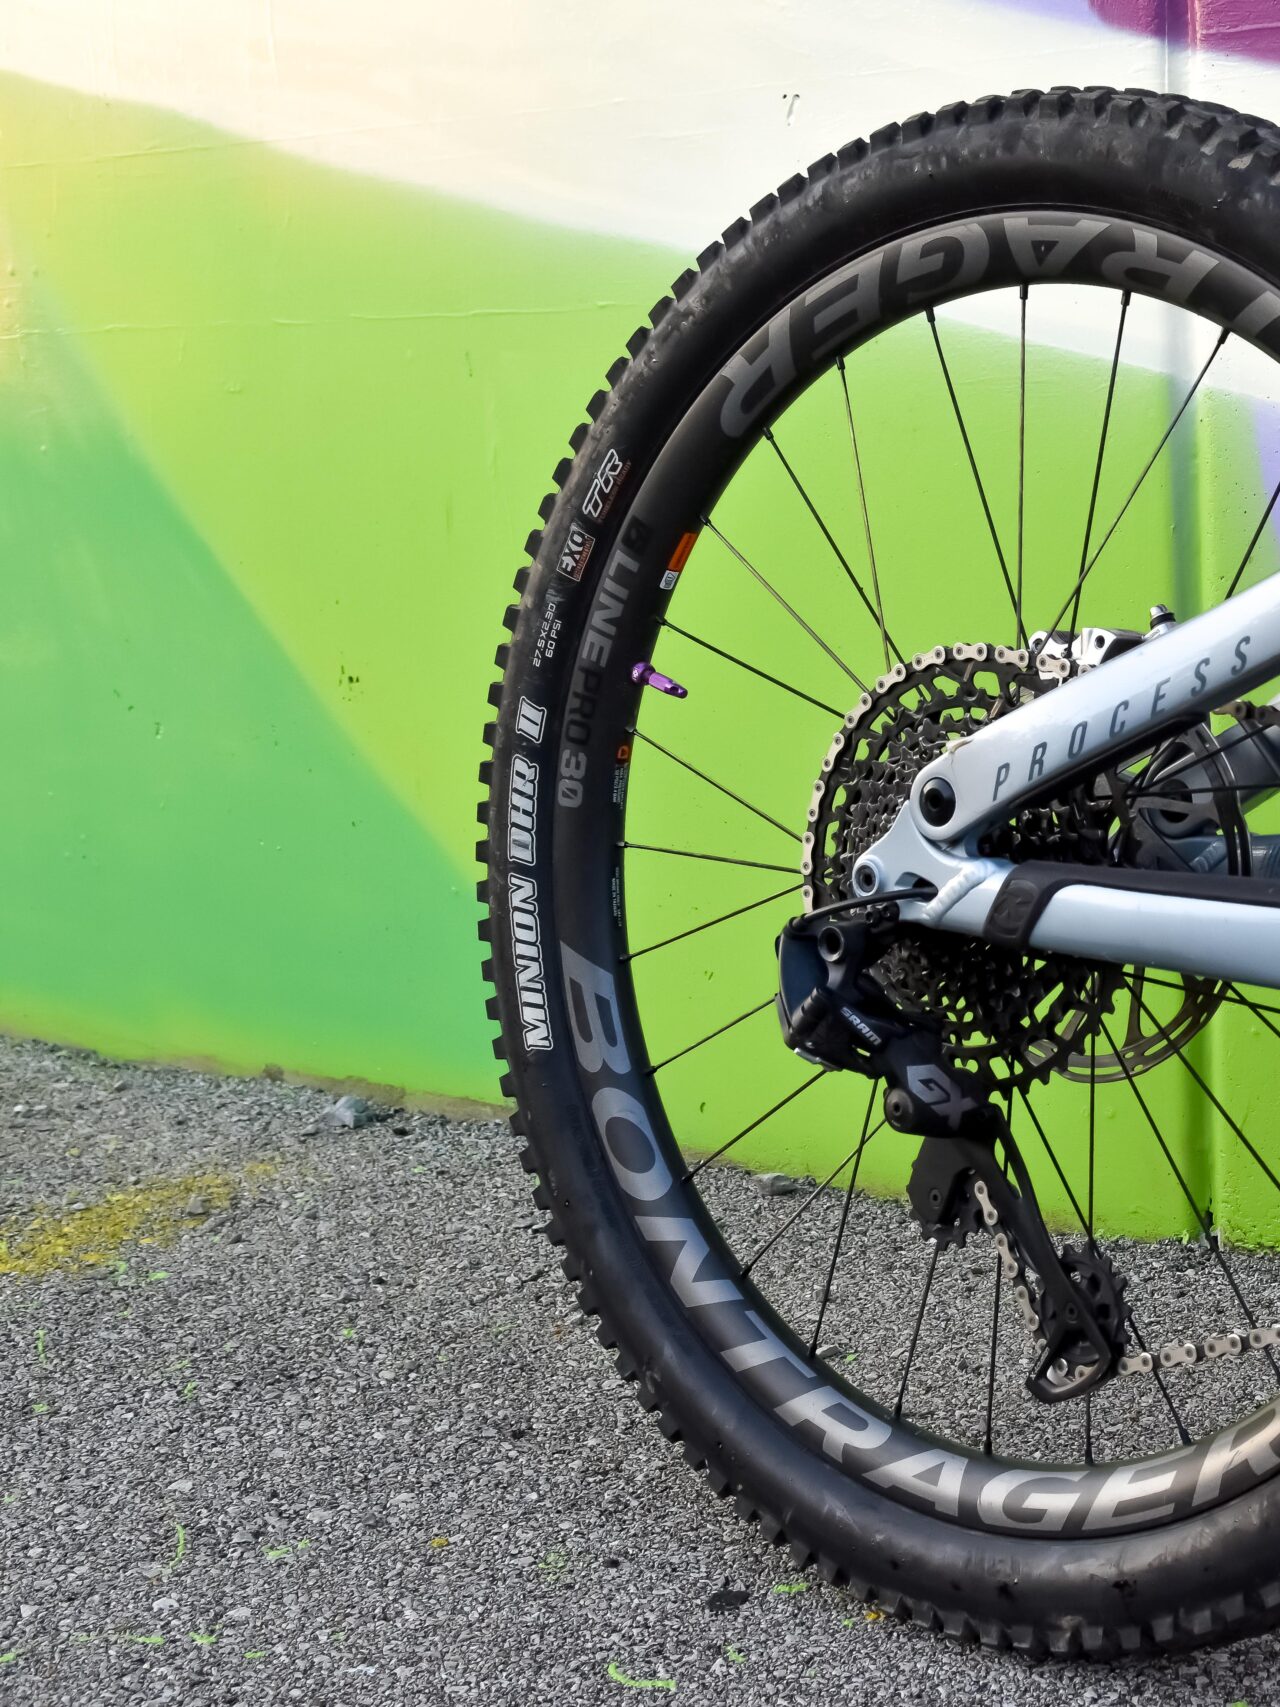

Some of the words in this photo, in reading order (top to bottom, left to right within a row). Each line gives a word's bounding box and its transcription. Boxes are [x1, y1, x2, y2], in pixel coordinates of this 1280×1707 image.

[581, 448, 624, 518] TR
[557, 529, 589, 573] EXO
[532, 602, 556, 667] 27.5X2.30
[550, 620, 563, 640] PSI
[582, 549, 642, 668] LINE
[545, 639, 556, 659] 60
[516, 696, 547, 744] II
[563, 666, 602, 746] PRO
[992, 635, 1253, 802] PROCESS
[508, 754, 539, 866] DHR
[557, 748, 587, 809] 30
[508, 873, 554, 1051] MINION
[840, 1006, 882, 1048] SRAM
[907, 1064, 979, 1130] GX
